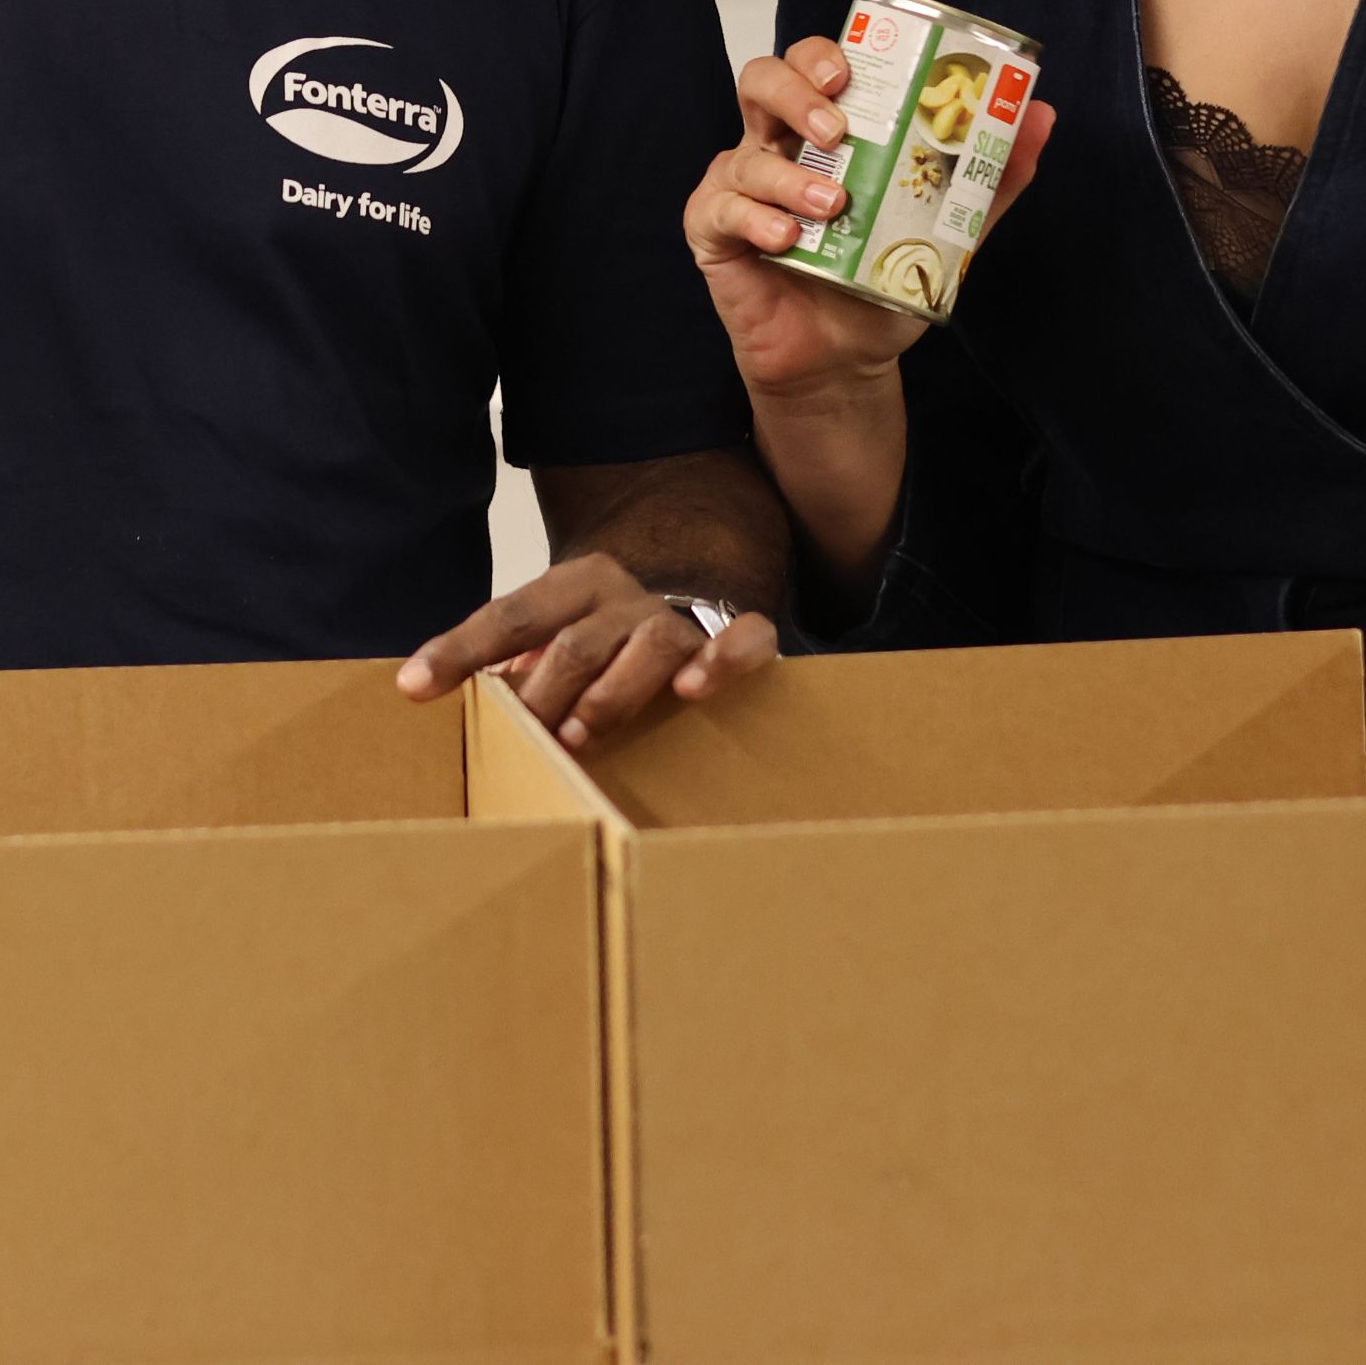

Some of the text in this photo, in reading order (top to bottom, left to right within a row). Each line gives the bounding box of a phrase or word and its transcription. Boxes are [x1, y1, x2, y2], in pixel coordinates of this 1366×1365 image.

[973, 130, 1013, 165] SLICE
[282, 178, 432, 235] Dairy for life
